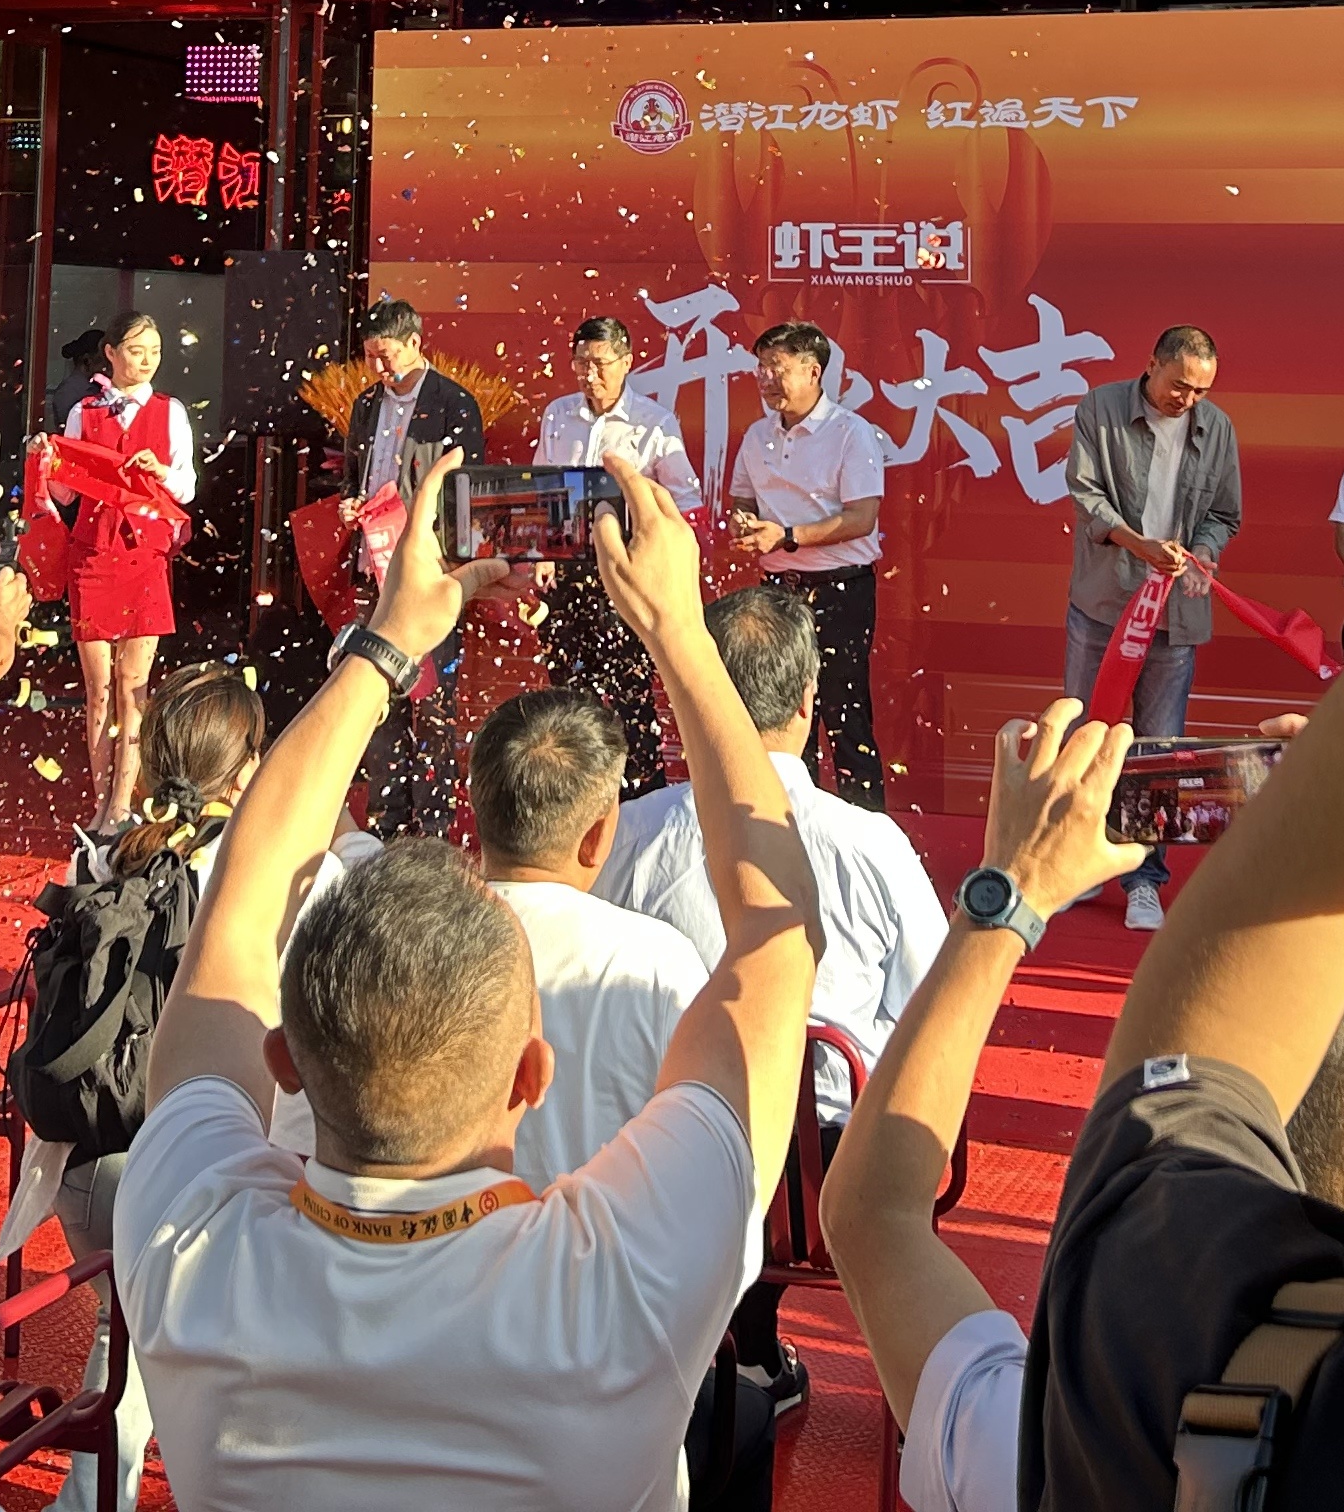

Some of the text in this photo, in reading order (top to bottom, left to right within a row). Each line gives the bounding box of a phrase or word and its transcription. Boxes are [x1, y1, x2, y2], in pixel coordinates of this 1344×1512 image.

[699, 96, 1139, 132] 潜江龙虾 红遍天下
[775, 221, 964, 273] 虾王说
[811, 275, 913, 286] XIAWANGSHUO
[629, 284, 1115, 526] 开大吉
[333, 1214, 350, 1231] OF
[355, 1220, 392, 1238] BANK
[400, 1200, 474, 1240] 中国银行
